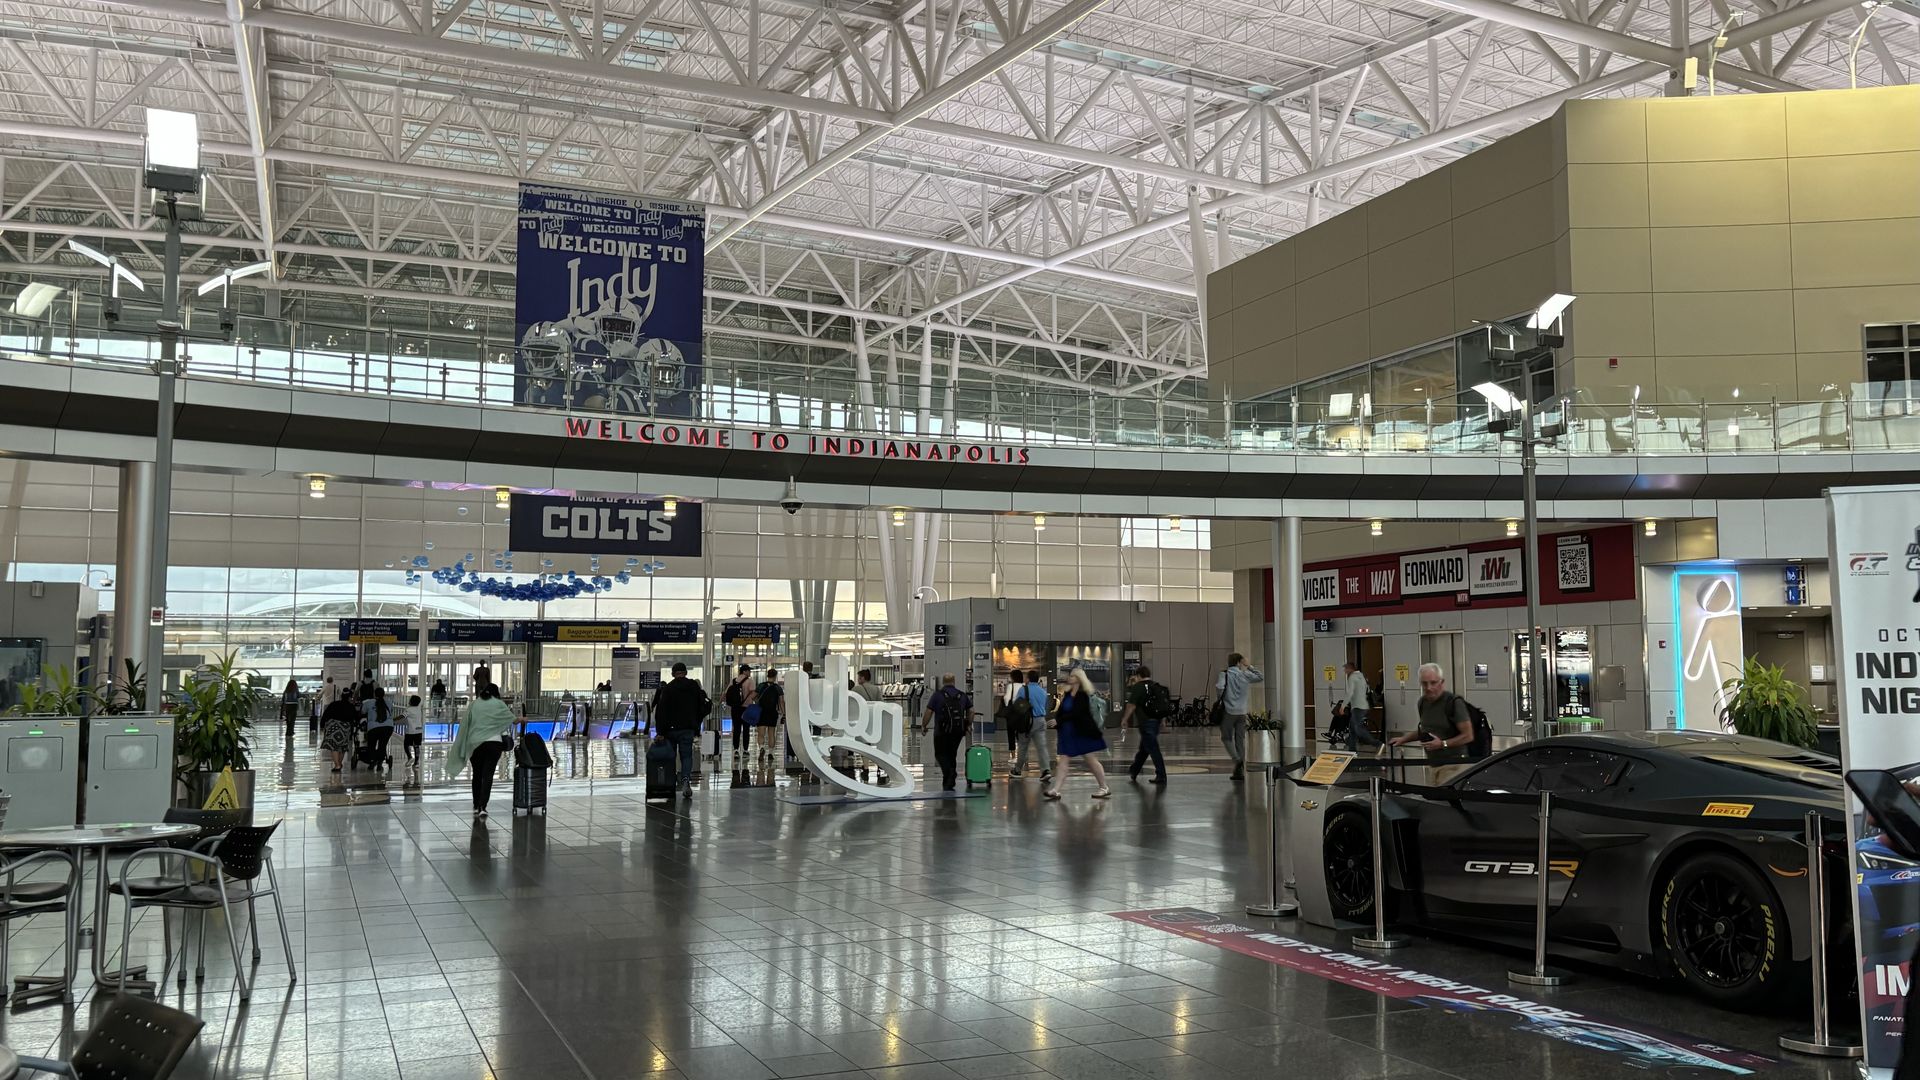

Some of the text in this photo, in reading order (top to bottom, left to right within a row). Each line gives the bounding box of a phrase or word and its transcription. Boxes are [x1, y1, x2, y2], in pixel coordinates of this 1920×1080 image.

[520, 214, 565, 235] TO Indy
[544, 198, 662, 226] WELCOME TO Indy
[537, 231, 688, 263] WELCOME TO
[582, 223, 685, 241] WELCOME TO Indy
[557, 256, 659, 326] Indy
[565, 417, 1031, 465] WELCOME TO INDIANAPOLIS
[542, 505, 672, 542] COLTS
[1345, 577, 1360, 595] THE
[1370, 569, 1396, 596] WAY
[1404, 557, 1464, 587] FORWARD
[1855, 652, 1920, 679] IND
[1706, 804, 1750, 816] PIRELLI
[1758, 903, 1776, 983] PIRELLI
[1320, 952, 1403, 971] ONLY
[1386, 970, 1492, 995] NIGHT
[1477, 994, 1584, 1019] RACE
